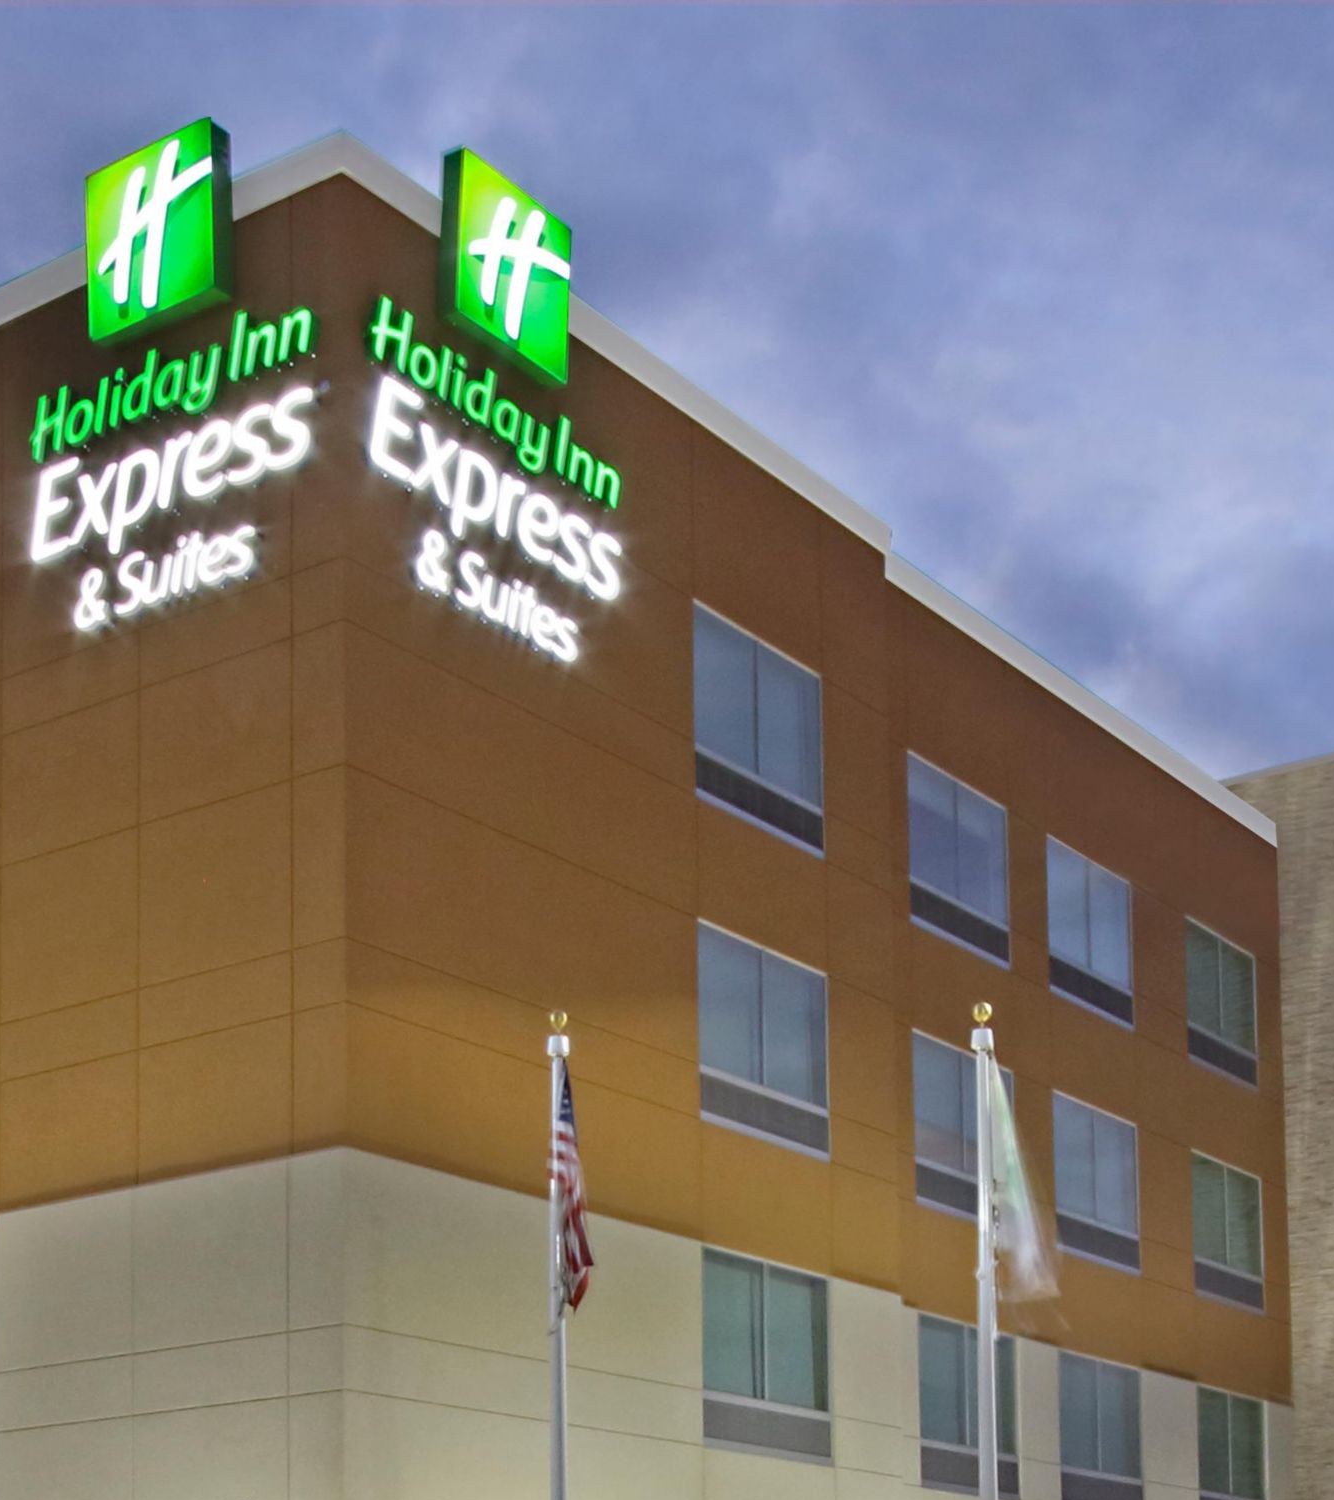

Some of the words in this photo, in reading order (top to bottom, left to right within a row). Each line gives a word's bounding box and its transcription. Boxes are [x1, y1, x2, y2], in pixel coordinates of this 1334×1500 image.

[29, 343, 222, 464] Holiday
[228, 305, 313, 382] Inn
[371, 294, 550, 475] Holiday
[555, 414, 622, 510] Inn
[30, 386, 315, 563] Express
[369, 375, 623, 600] Express
[73, 567, 108, 632] &
[114, 524, 258, 616] Suites
[415, 529, 451, 594] &
[454, 550, 579, 663] Suites
